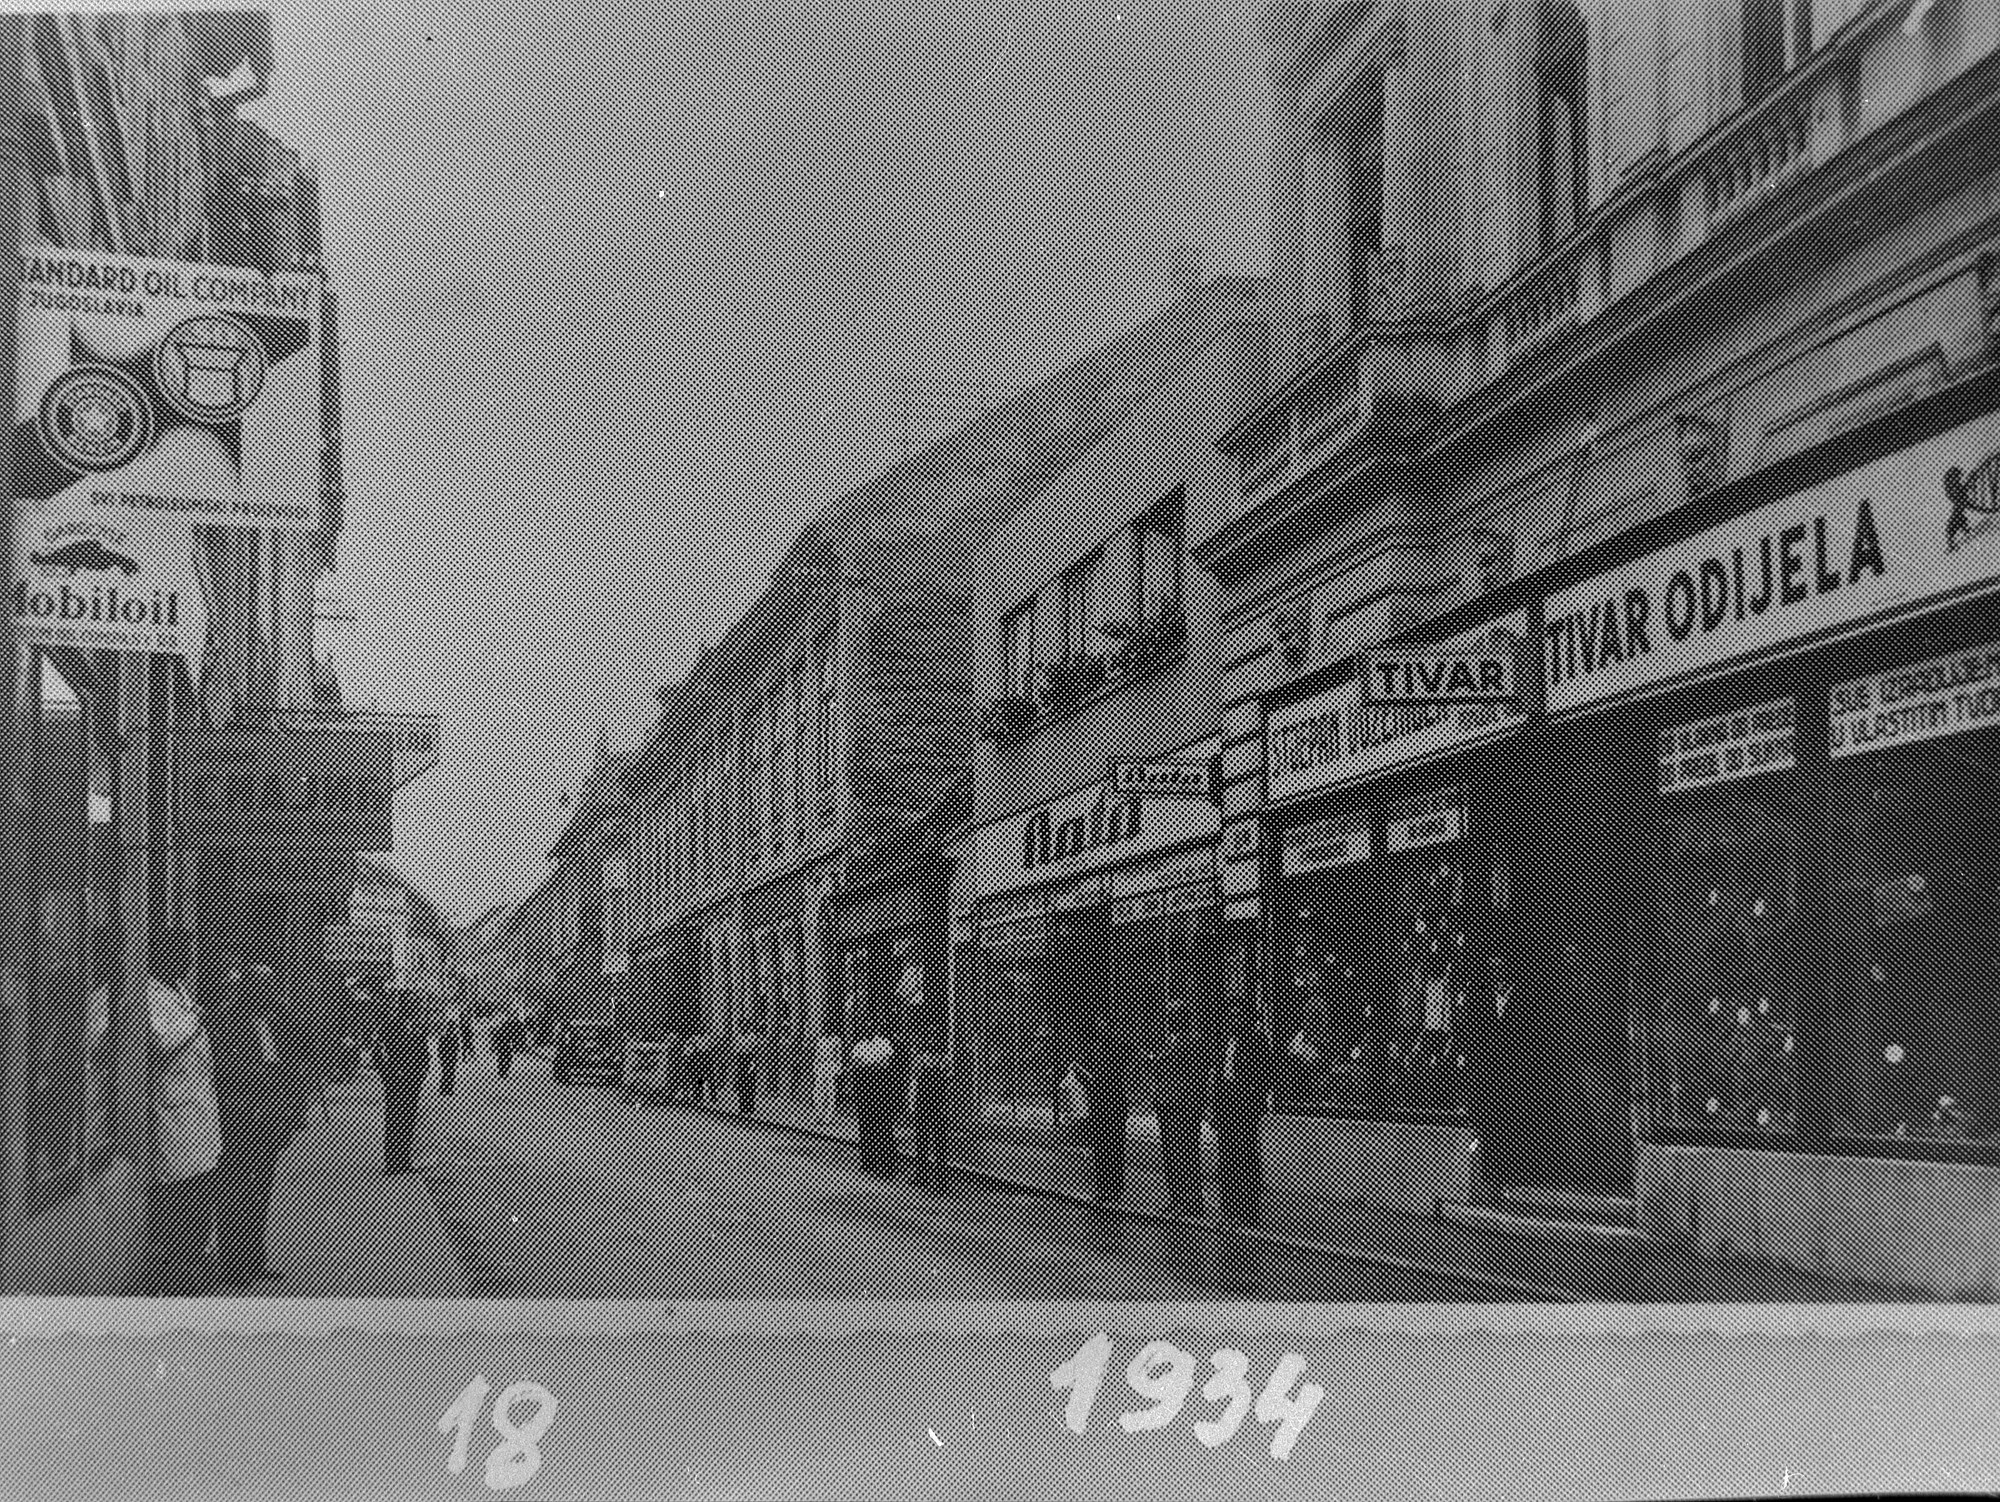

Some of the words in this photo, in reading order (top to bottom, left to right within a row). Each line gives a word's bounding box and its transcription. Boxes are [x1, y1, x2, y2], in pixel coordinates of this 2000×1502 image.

[28, 291, 146, 318] JUGOSLAVIA
[144, 270, 187, 299] OIL
[192, 276, 312, 311] COMPANY
[89, 491, 116, 507] SVI
[1545, 586, 1651, 686] TIVAR
[1665, 497, 1886, 643] ODIJELA
[1375, 659, 1505, 695] TIVAR
[1050, 1331, 1325, 1460] 1934
[437, 1373, 559, 1490] 18
